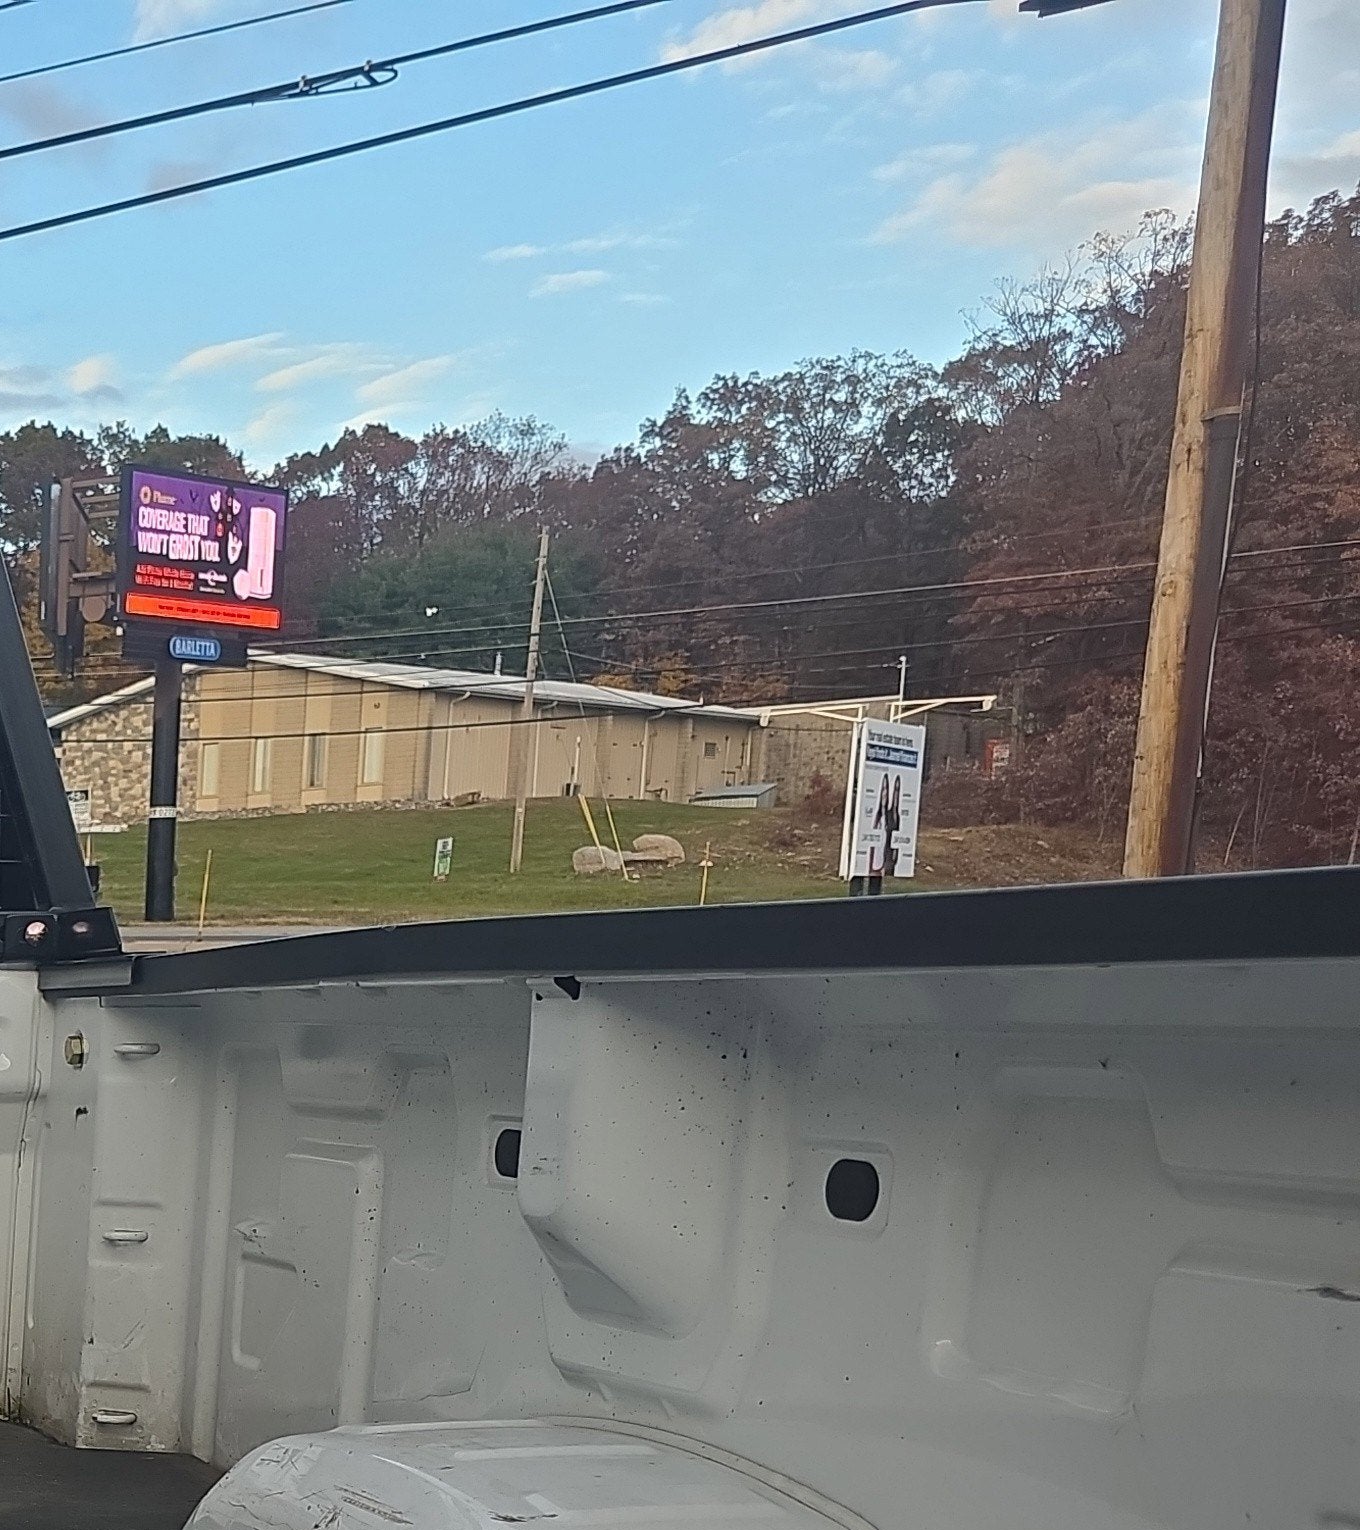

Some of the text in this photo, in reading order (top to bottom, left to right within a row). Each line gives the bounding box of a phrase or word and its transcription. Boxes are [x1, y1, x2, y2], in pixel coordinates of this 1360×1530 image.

[138, 505, 210, 536] COVERAGE THAT
[168, 533, 202, 561] GHOST
[175, 638, 216, 657] BARLETTA
